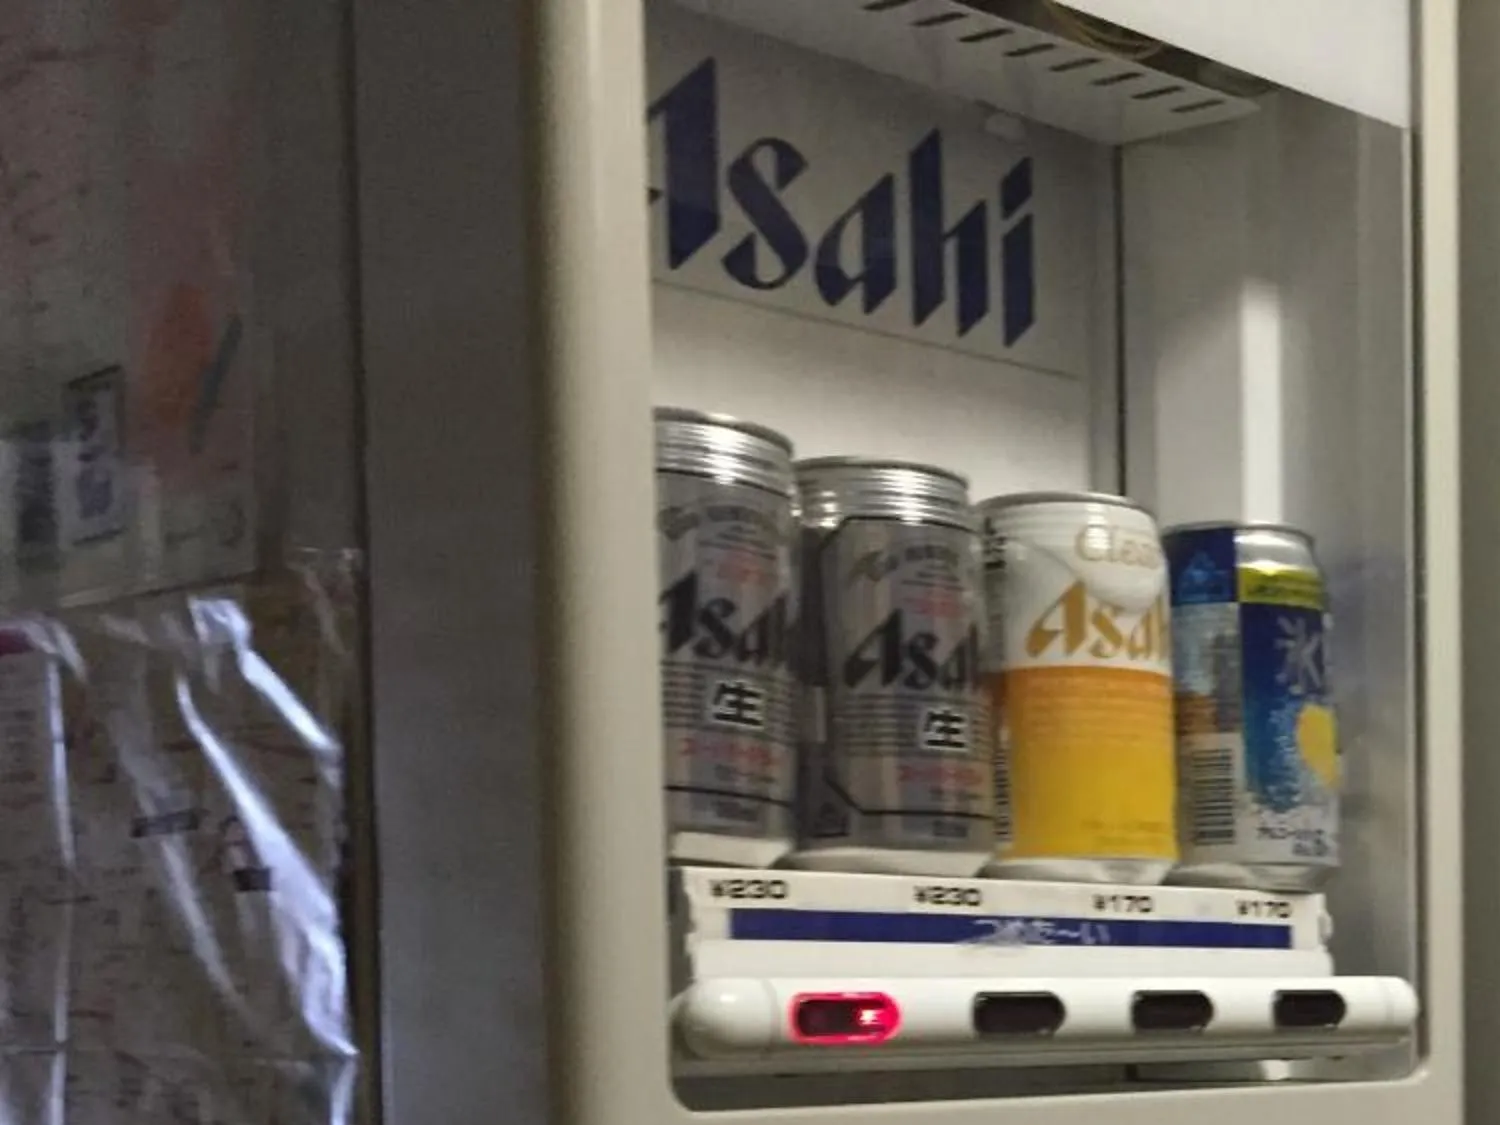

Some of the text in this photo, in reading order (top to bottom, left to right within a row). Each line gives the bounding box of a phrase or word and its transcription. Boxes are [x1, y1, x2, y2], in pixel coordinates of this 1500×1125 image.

[713, 681, 763, 728] 生
[923, 709, 966, 750] 生
[710, 879, 789, 899] ¥230
[914, 886, 982, 907] ¥230
